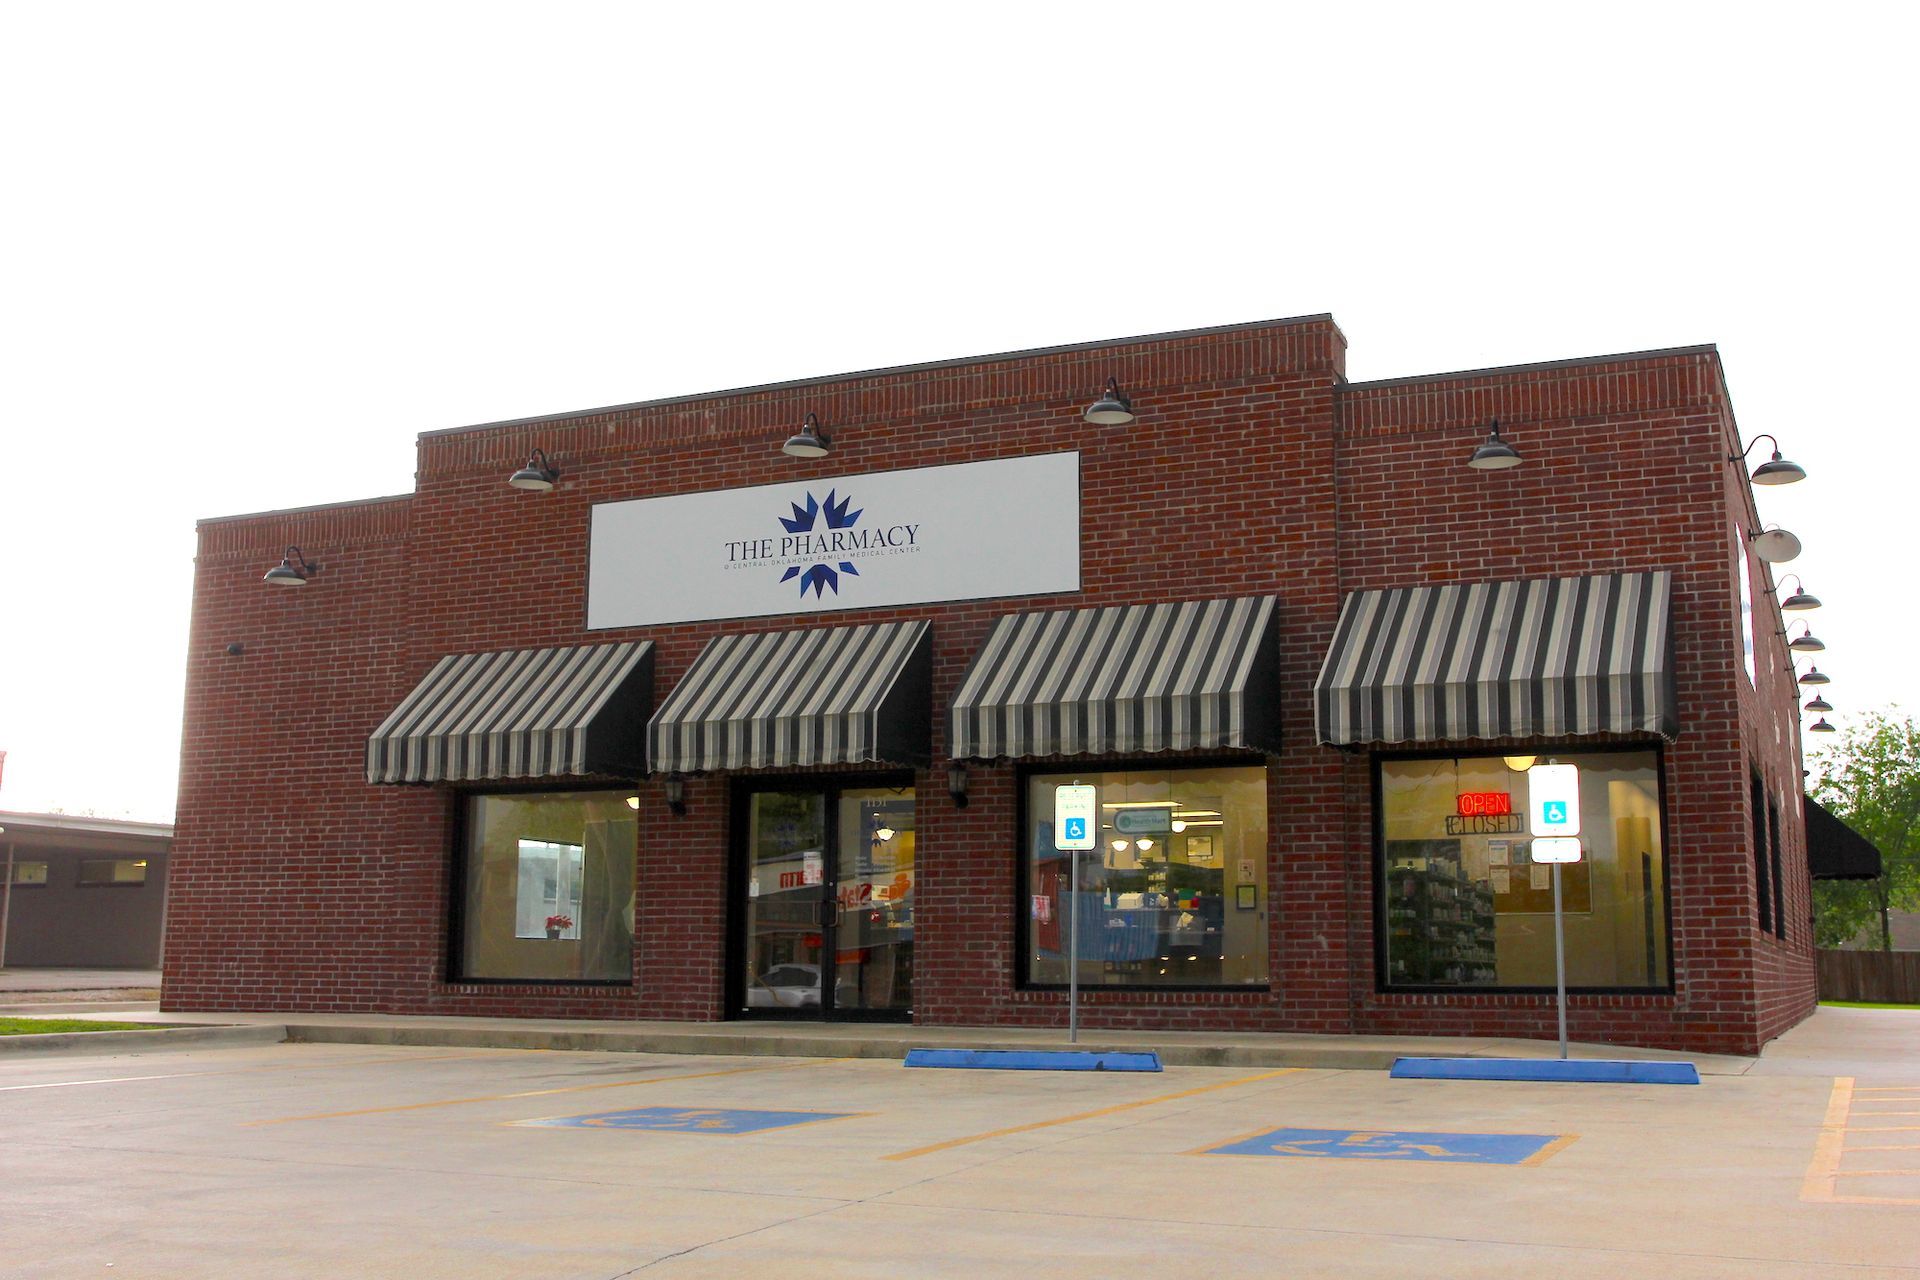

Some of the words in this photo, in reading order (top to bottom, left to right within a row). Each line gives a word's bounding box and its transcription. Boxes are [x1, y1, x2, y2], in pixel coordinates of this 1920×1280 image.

[725, 538, 773, 562] THE
[780, 523, 920, 557] PHARMACY
[733, 560, 768, 570] CENTRAL
[771, 556, 814, 567] OKLAHOMA
[817, 552, 847, 562] FAMILY
[850, 548, 885, 559] MEDICAL
[889, 545, 921, 556] CENTER
[1461, 794, 1508, 814] OPEN
[1450, 814, 1520, 833] CLOSED
